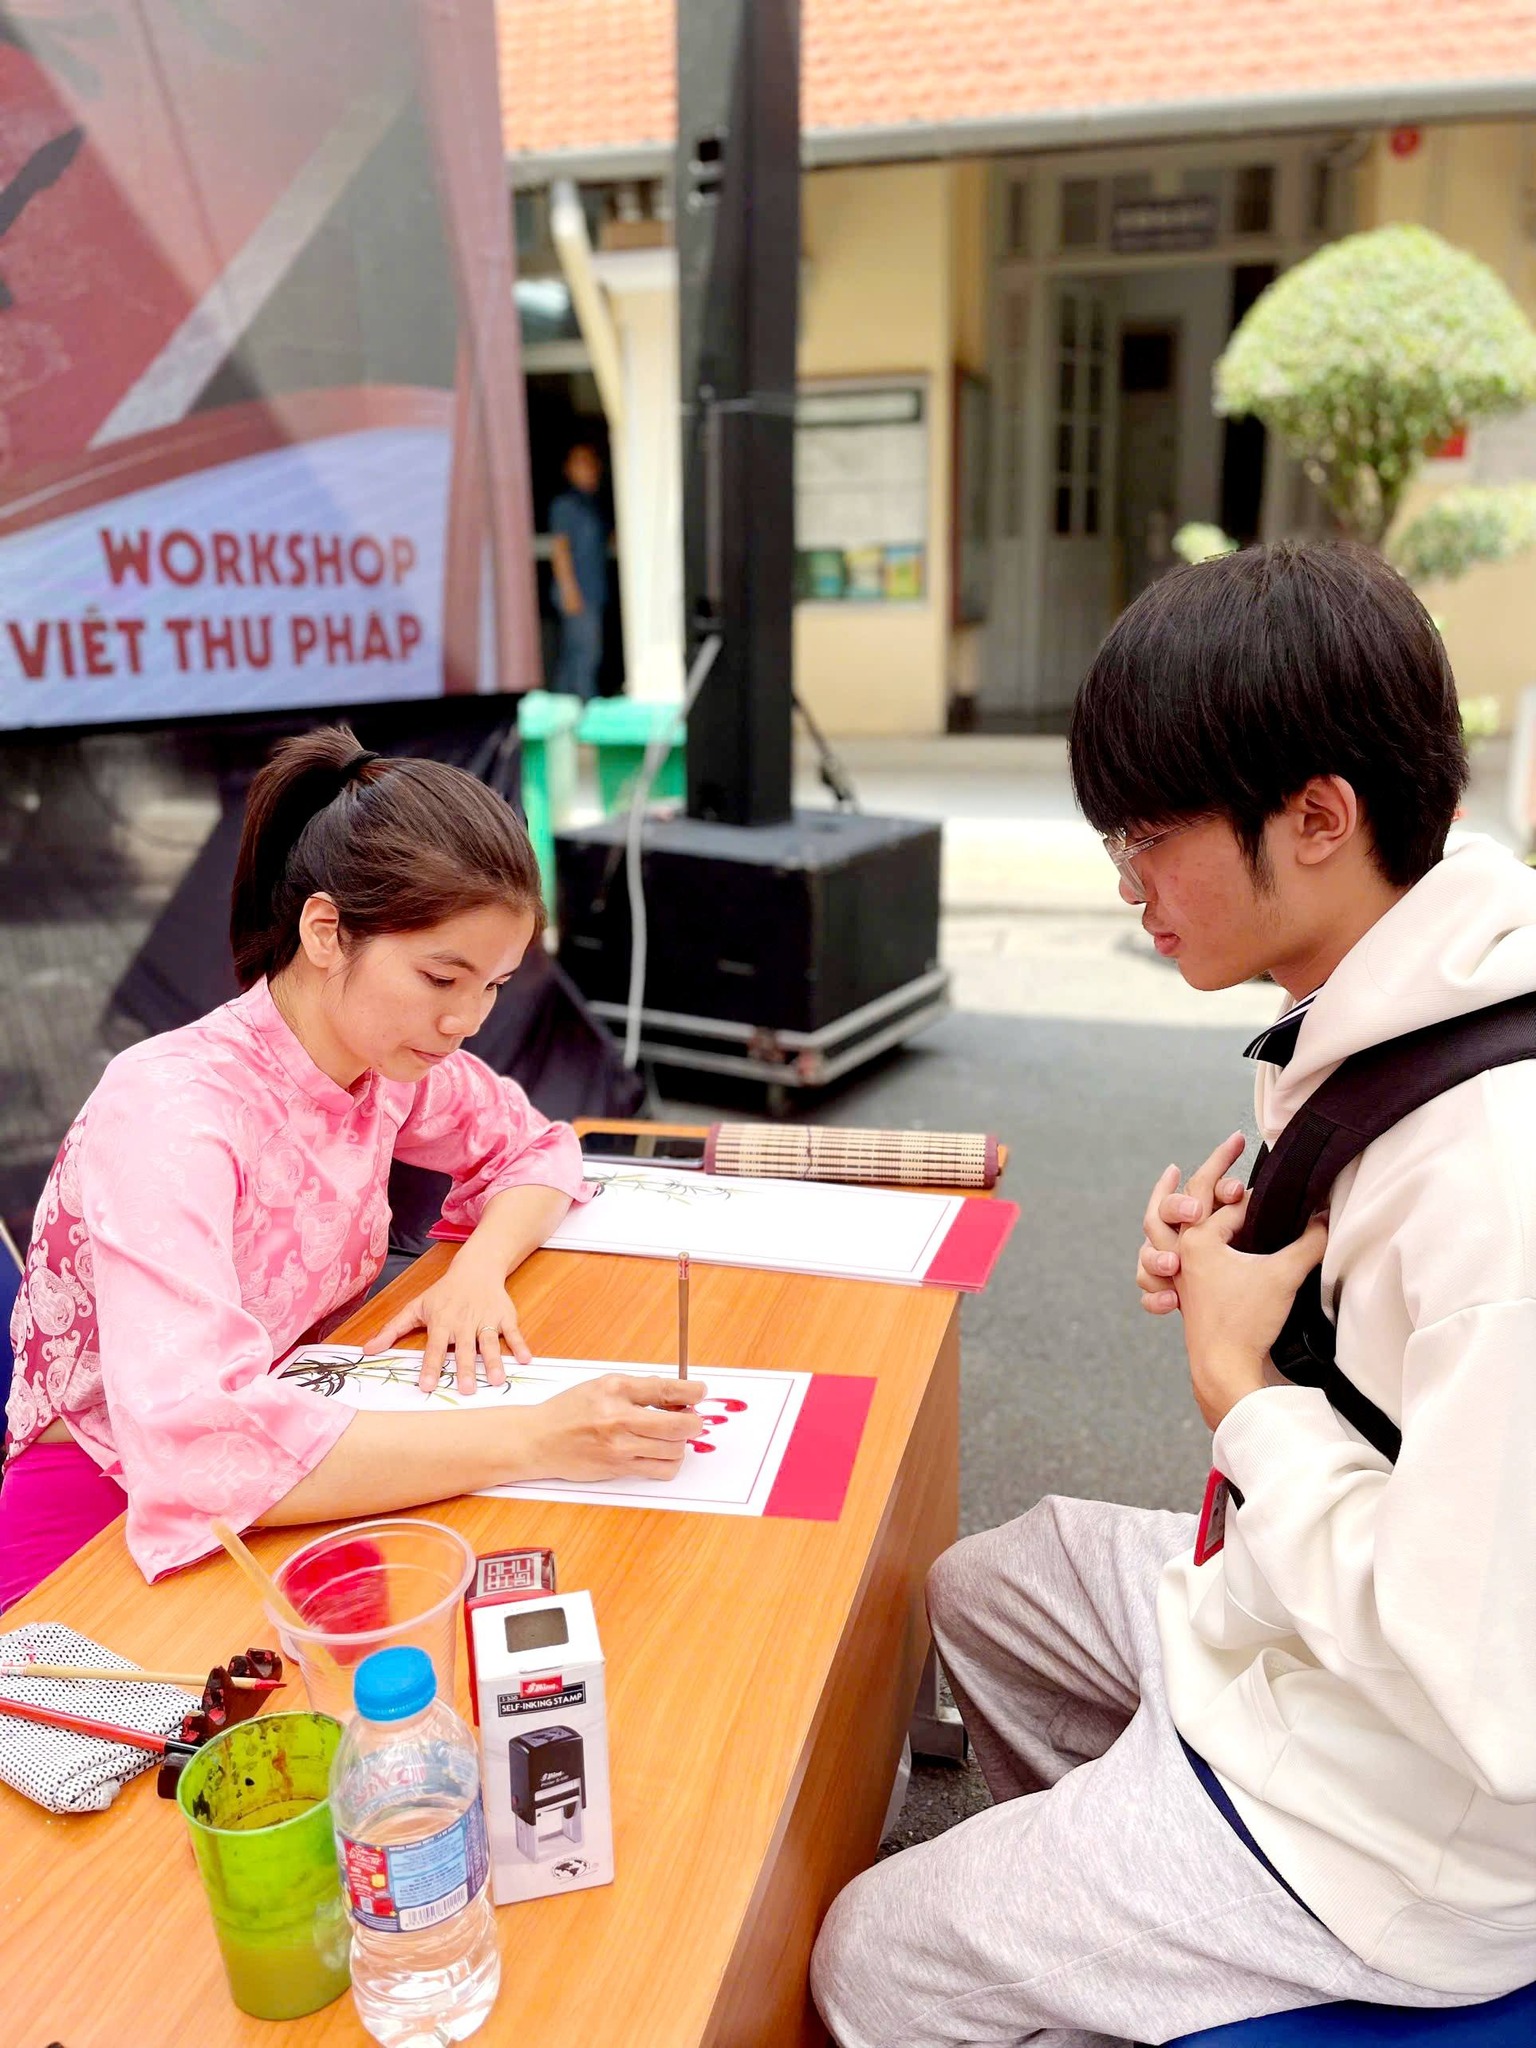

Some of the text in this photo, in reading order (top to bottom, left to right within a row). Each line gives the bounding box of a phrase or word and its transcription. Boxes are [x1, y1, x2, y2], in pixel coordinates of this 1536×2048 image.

[98, 529, 416, 586] WORKSHOP
[501, 1692, 582, 1712] SELF-INKING STAMP
